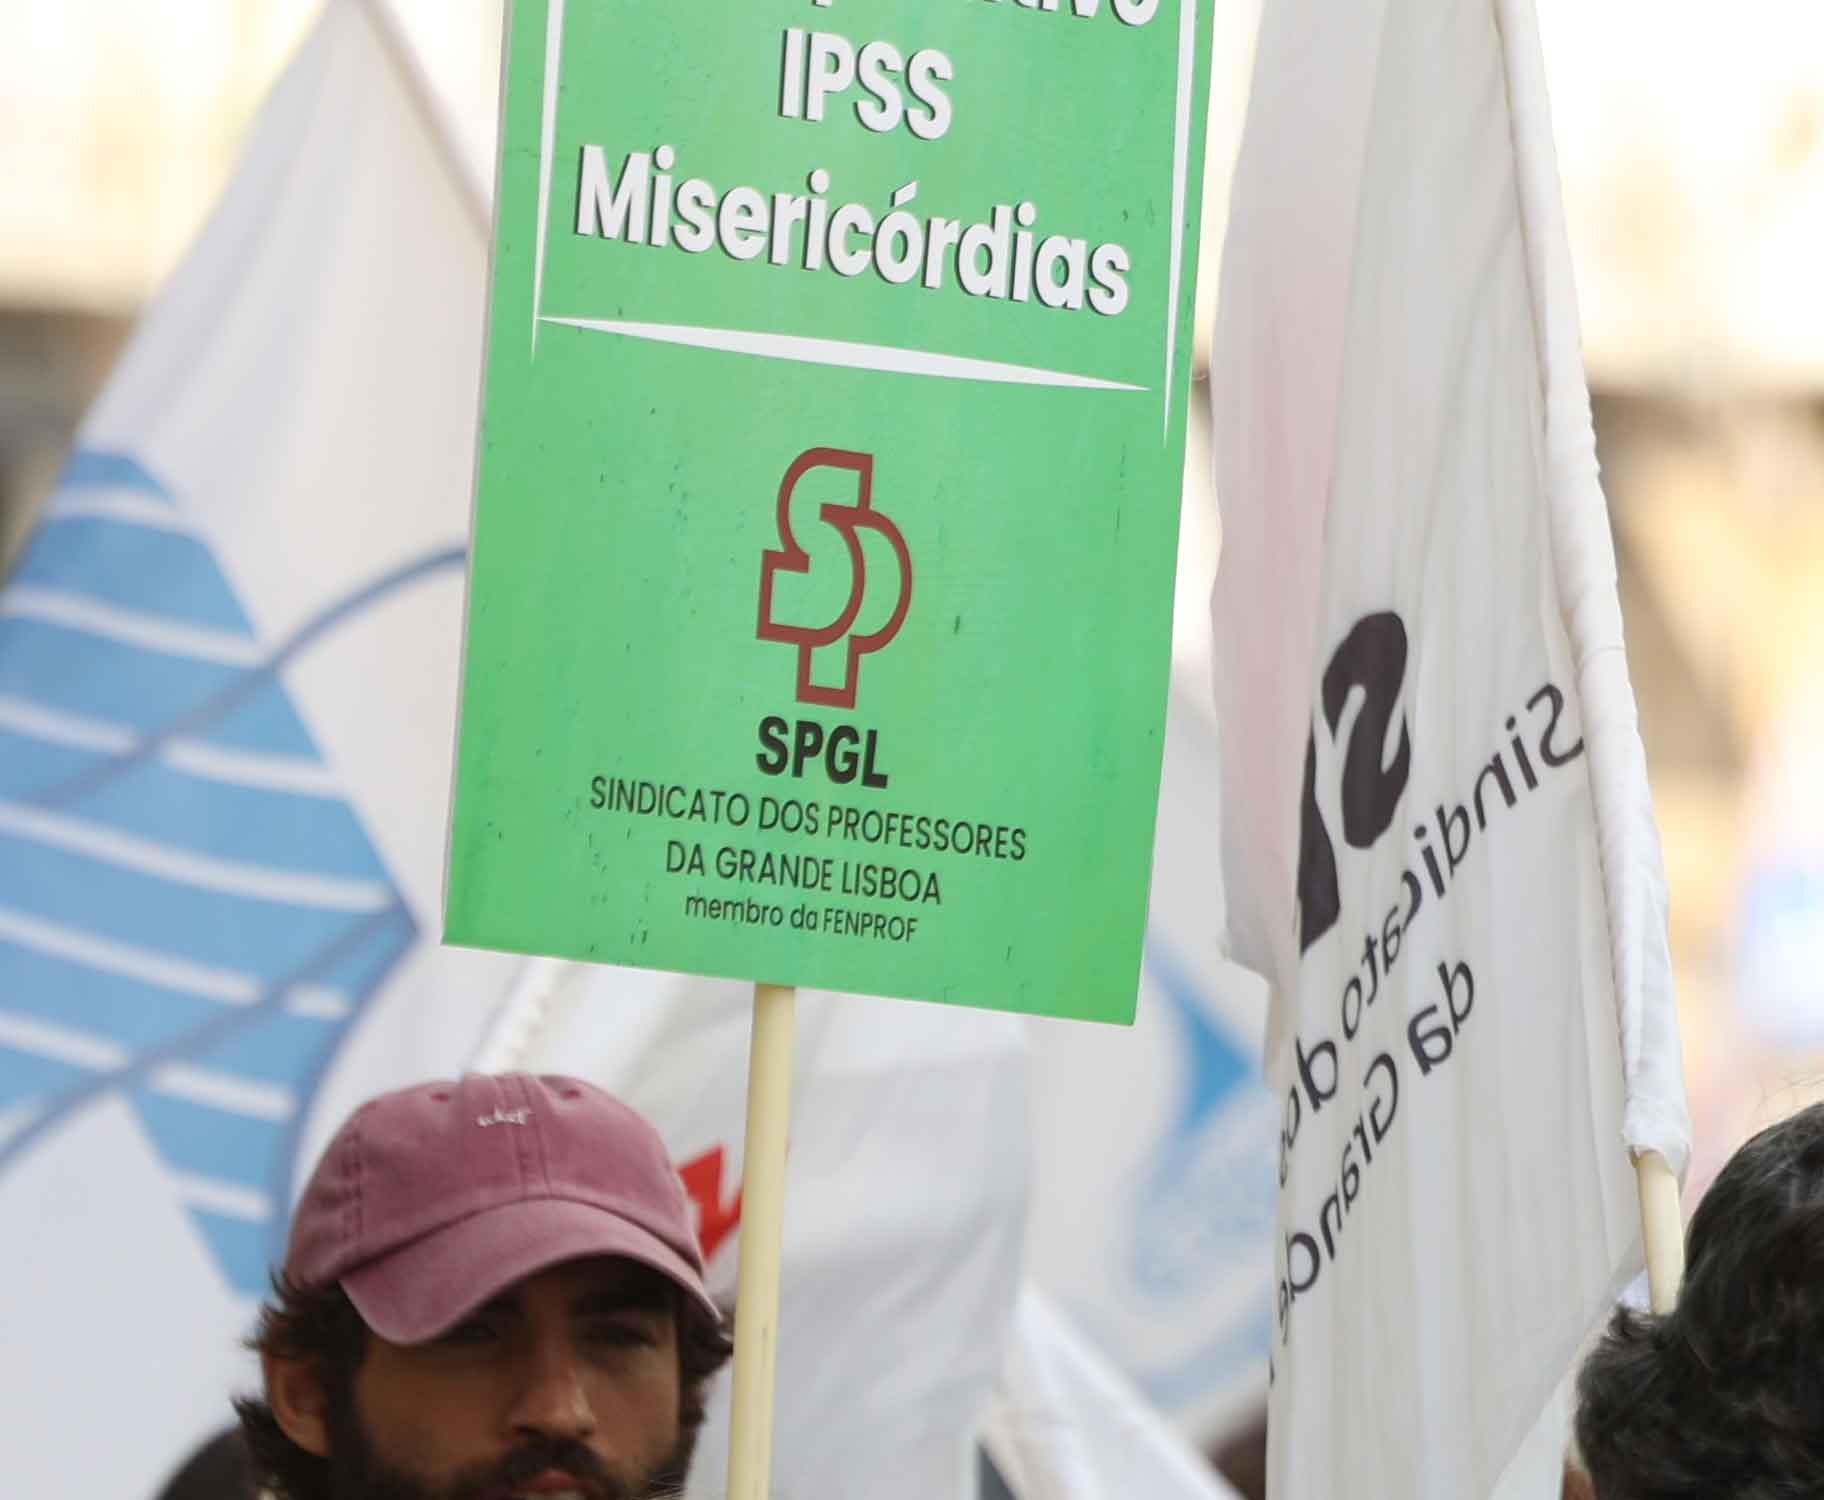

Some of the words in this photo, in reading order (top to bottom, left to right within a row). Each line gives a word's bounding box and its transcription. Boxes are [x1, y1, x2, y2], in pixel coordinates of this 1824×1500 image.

[778, 27, 954, 141] IPSS
[574, 143, 1131, 316] Misericórdias
[755, 715, 889, 789] SPGL
[589, 774, 751, 827] SINDICATO
[757, 796, 819, 836] DOS
[826, 804, 1027, 862] PROFESSORES
[665, 839, 706, 877] DA
[715, 845, 833, 892] GRANDE
[841, 862, 943, 906] LISBOA
[684, 893, 784, 928] membro
[789, 903, 819, 932] da
[822, 906, 919, 943] FENPROF
